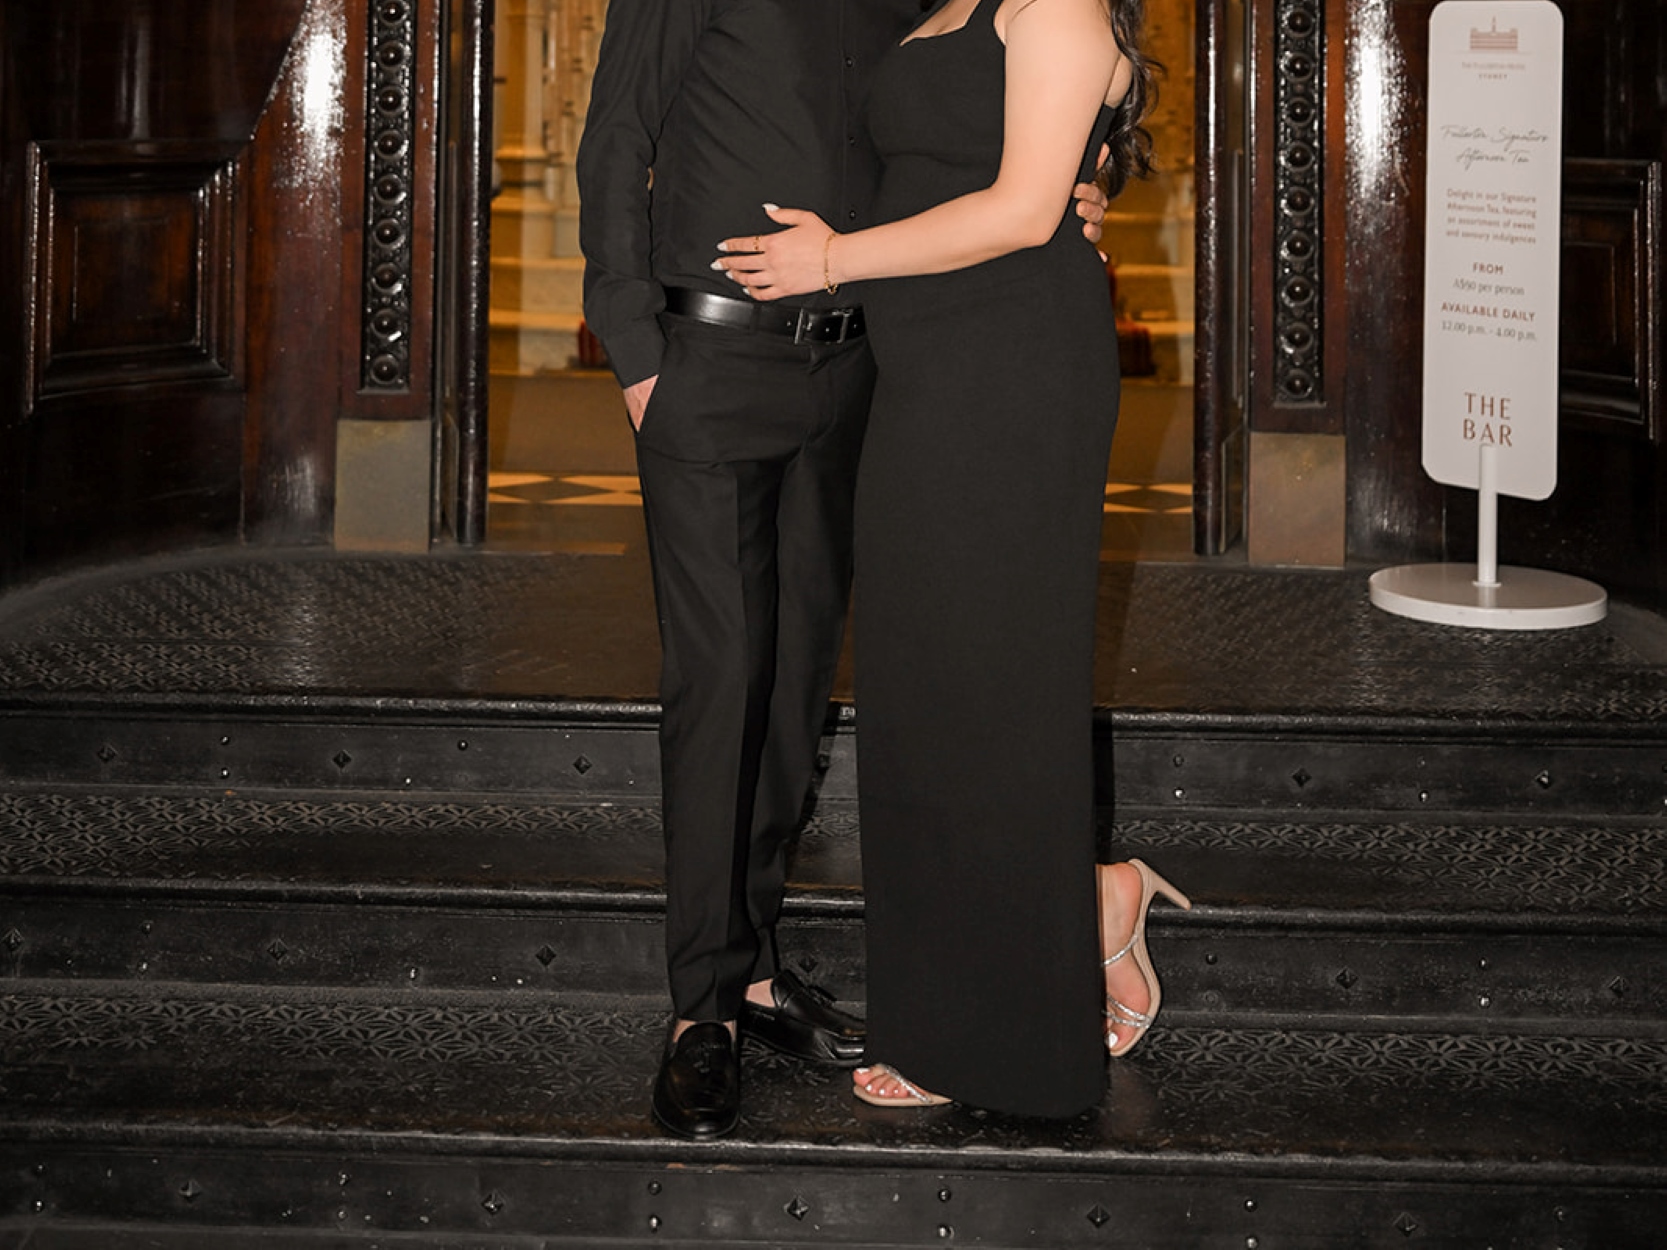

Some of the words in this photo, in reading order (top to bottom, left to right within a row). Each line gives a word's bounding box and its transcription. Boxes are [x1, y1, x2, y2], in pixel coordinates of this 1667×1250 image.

[1472, 262, 1503, 275] FROM
[1441, 301, 1497, 318] AVAILABLE
[1502, 308, 1536, 322] DAILY
[1463, 391, 1512, 421] THE
[1463, 418, 1513, 448] BAR
